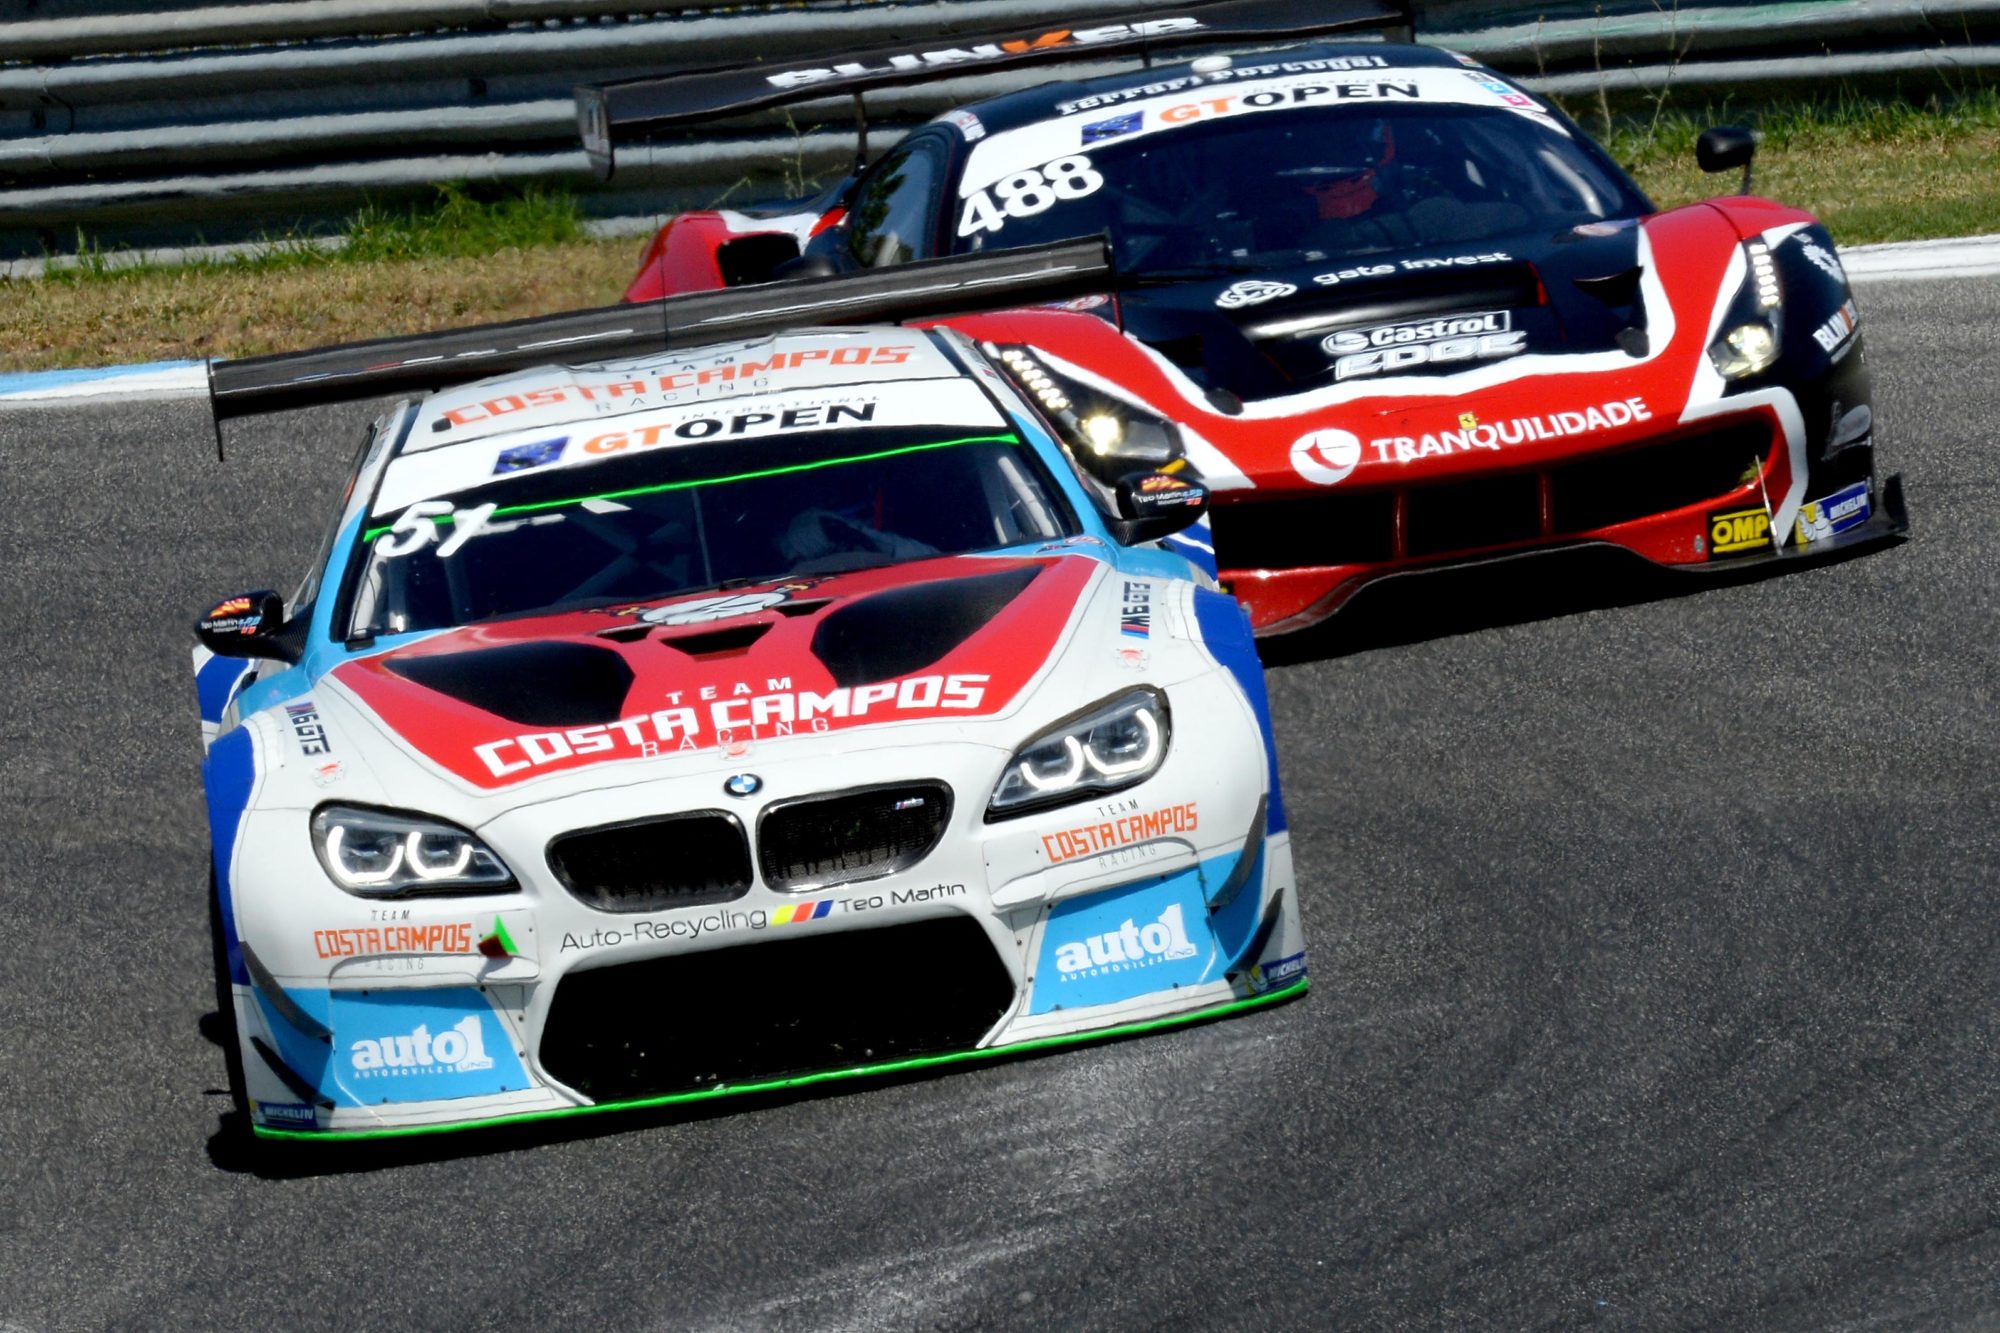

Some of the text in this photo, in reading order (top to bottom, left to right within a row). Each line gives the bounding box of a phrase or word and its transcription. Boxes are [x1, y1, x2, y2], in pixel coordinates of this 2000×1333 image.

[1056, 56, 1390, 116] Ferrari Portugal
[957, 154, 1104, 237] 488
[1312, 251, 1513, 285] gate invest
[1370, 313, 1500, 347] Castrol
[625, 356, 735, 380] TEAM
[1335, 330, 1529, 381] EDGE
[442, 345, 916, 425] COSTA CAMPOS
[596, 376, 769, 413] RACING
[1370, 396, 1653, 462] TRANQUILIDADE
[1712, 513, 1769, 545] OMP
[665, 677, 792, 705] TEAM
[472, 673, 992, 778] COSTA CAMPOS
[642, 717, 829, 758] RACING
[1096, 799, 1139, 817] TEAM
[1041, 802, 1198, 864] COSTA CAMPOS
[371, 909, 411, 921] TEAM
[838, 882, 967, 914] Teo Martin
[313, 923, 472, 960] COSTA CAMPOS
[560, 907, 767, 953] Auto-Recycling
[1055, 903, 1197, 973] auto1
[1059, 956, 1163, 982] AUTOMOVILES
[351, 1015, 495, 1071] auto1
[354, 1066, 454, 1080] AUTOMOVILES
[265, 1107, 314, 1120] MICHELIN
